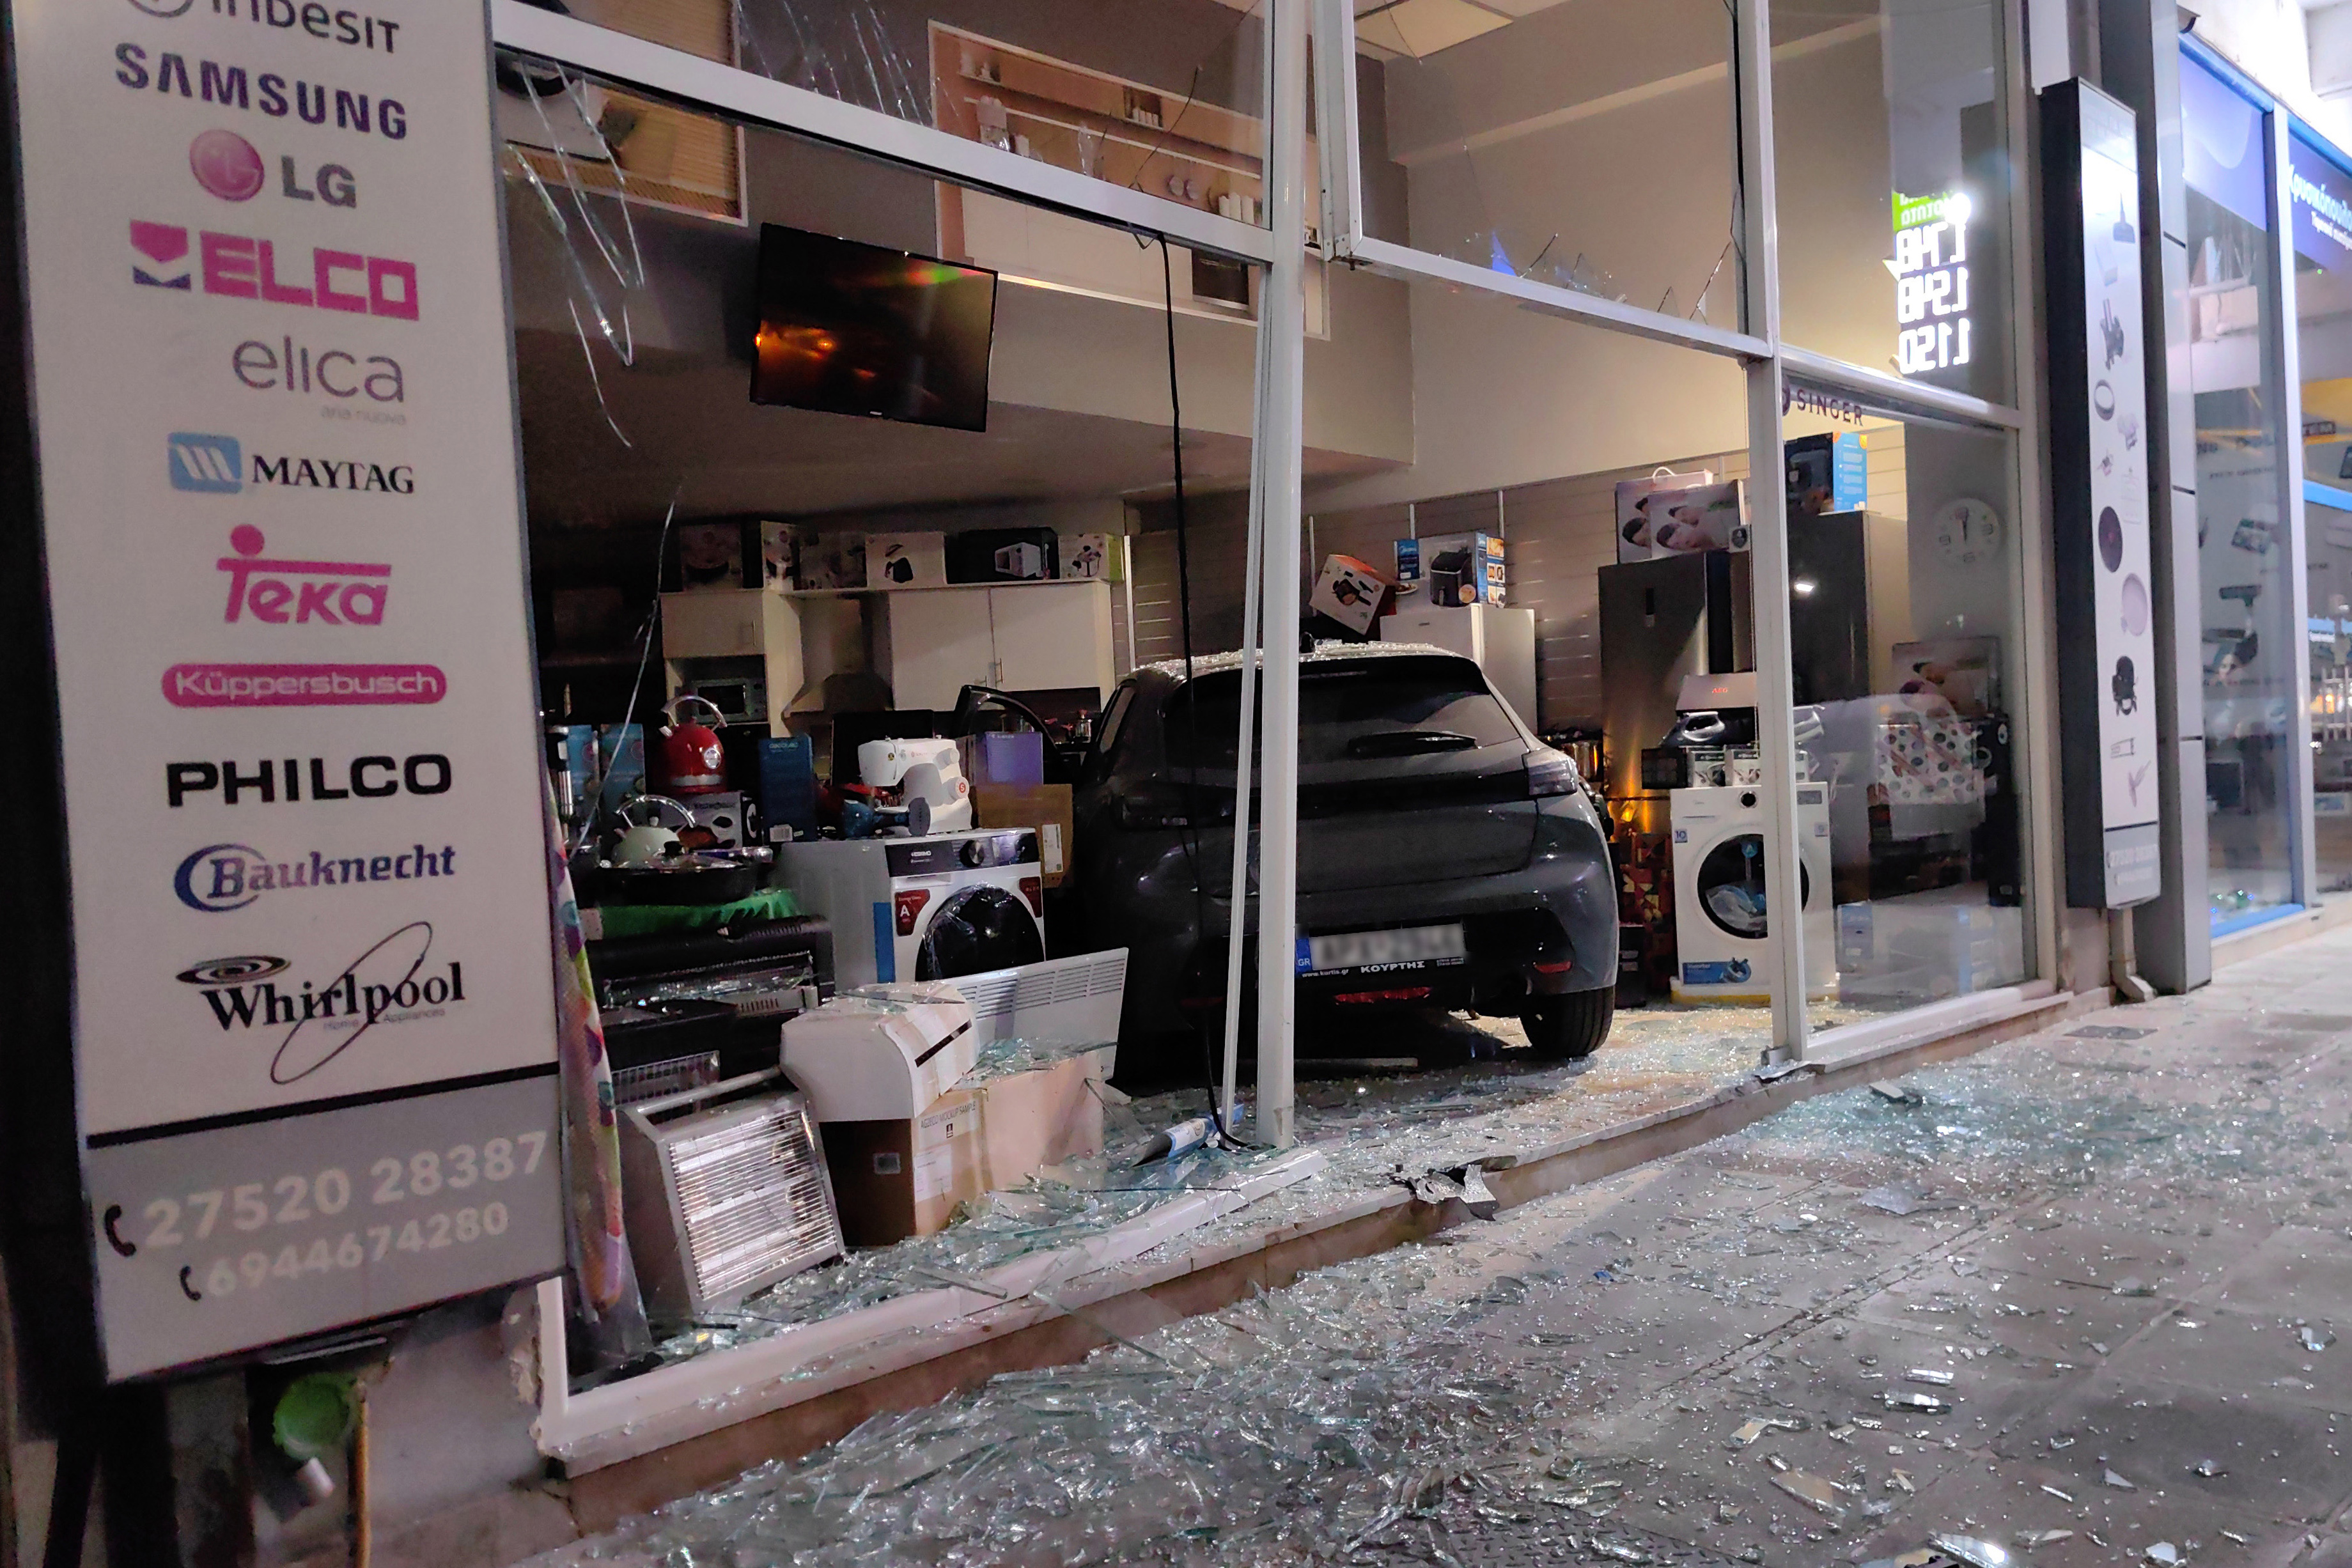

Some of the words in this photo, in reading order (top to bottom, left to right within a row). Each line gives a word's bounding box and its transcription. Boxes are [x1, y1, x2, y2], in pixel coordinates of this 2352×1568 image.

[115, 42, 407, 141] SAMSUNG
[281, 156, 357, 208] LG
[199, 231, 419, 321] ELCO
[233, 336, 404, 402] elica
[1796, 389, 1863, 426] SINGER
[252, 454, 414, 494] MAYTAG
[217, 554, 391, 625] Teka
[176, 671, 438, 700] Küppersbusch
[166, 754, 452, 808] PHILCO
[1675, 830, 1686, 839] 10
[206, 844, 456, 899] Bauknecht
[900, 904, 910, 917] A
[1298, 958, 1311, 966] GR
[1302, 968, 1349, 977] www.kurtis.gr
[1360, 961, 1425, 974] ΚΟΥΡΤΗΣ
[200, 961, 465, 1031] Whirlpool
[143, 1168, 351, 1247] 27520
[371, 1130, 547, 1206] 28387
[206, 1202, 509, 1297] 6944674280
